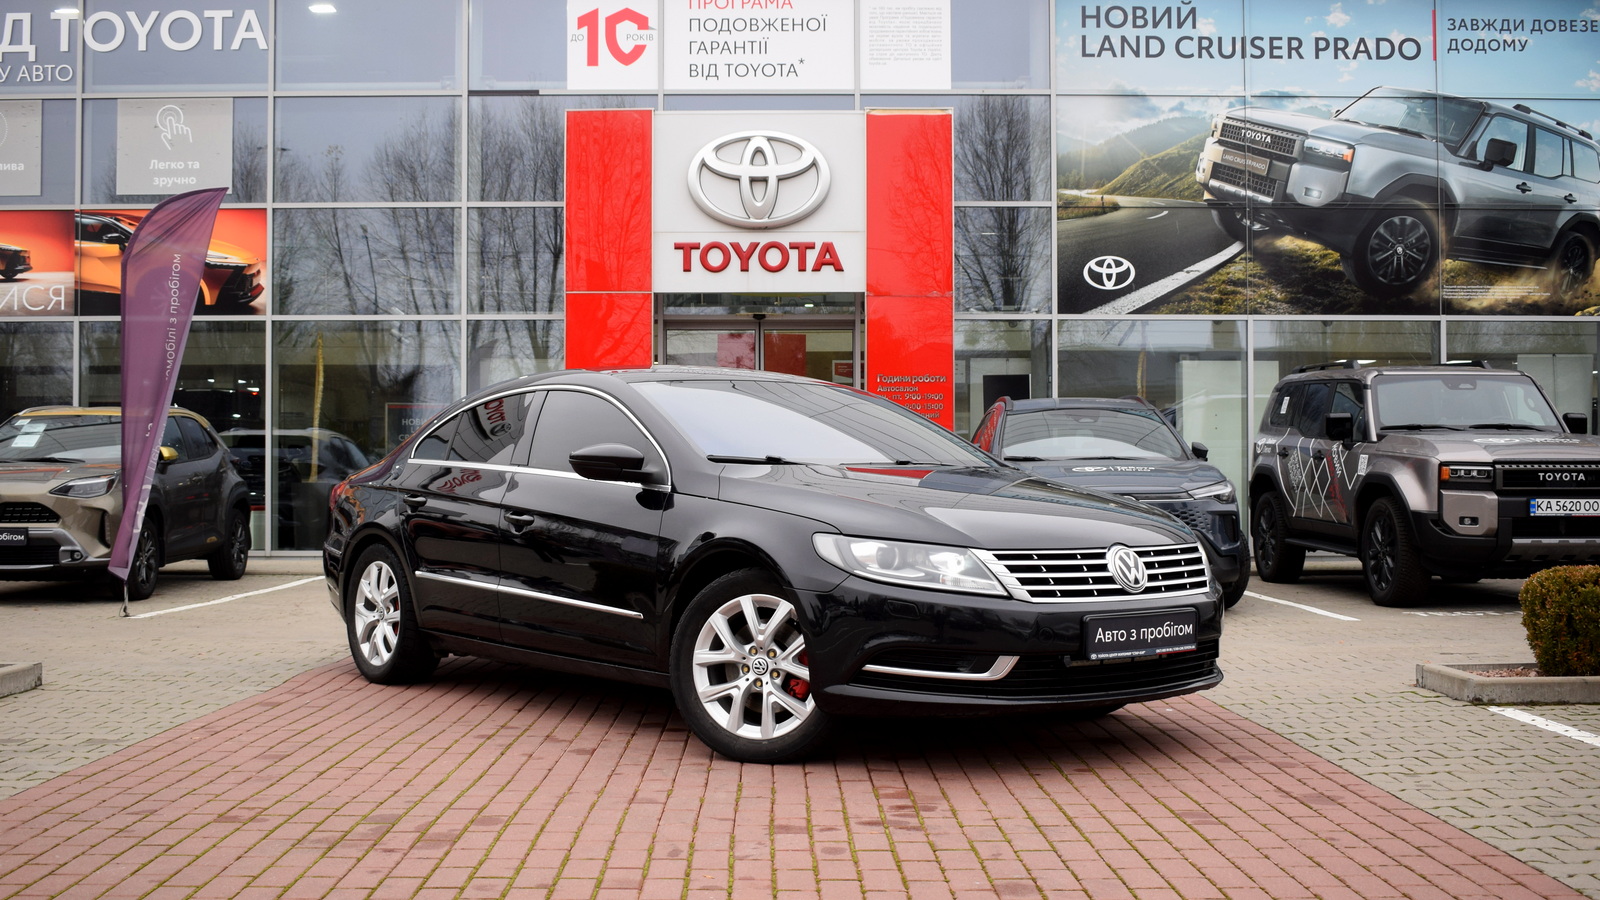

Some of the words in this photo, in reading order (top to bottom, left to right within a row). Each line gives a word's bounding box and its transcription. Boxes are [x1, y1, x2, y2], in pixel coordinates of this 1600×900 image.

[1081, 0, 1197, 29] НОВИЙ
[50, 9, 269, 52] TOYOTA
[689, 14, 828, 35] ПОДОВЖЕНОЇ
[1447, 18, 1525, 34] ЗАВЖДИ
[1530, 19, 1599, 35] ДОВЕЗЕ
[570, 34, 585, 43] ДО
[626, 33, 654, 41] РОКІВ
[689, 37, 769, 55] ГАРАНТІЇ
[1447, 38, 1528, 54] ДОДОМУ
[1081, 34, 1166, 58] LAND
[1174, 35, 1305, 60] CRUISER
[1314, 36, 1422, 60] PRADO
[16, 64, 74, 82] АВТО
[689, 63, 719, 80] ВІД
[1240, 129, 1271, 143] TOYOTA
[149, 159, 185, 171] Легко
[187, 160, 200, 170] та
[1222, 153, 1234, 162] LAND
[152, 175, 197, 187] зручно
[673, 241, 844, 273] TOYOTA
[168, 253, 182, 314] пробігом
[877, 374, 911, 384] Години
[911, 374, 947, 384] роботи
[1538, 472, 1586, 481] TOYOTA
[1536, 500, 1553, 512] KA
[1555, 500, 1582, 512] 5620
[1583, 500, 1600, 512] OO
[1095, 627, 1127, 643] Авто
[1129, 628, 1137, 640] з
[1140, 621, 1193, 642] пробігом
